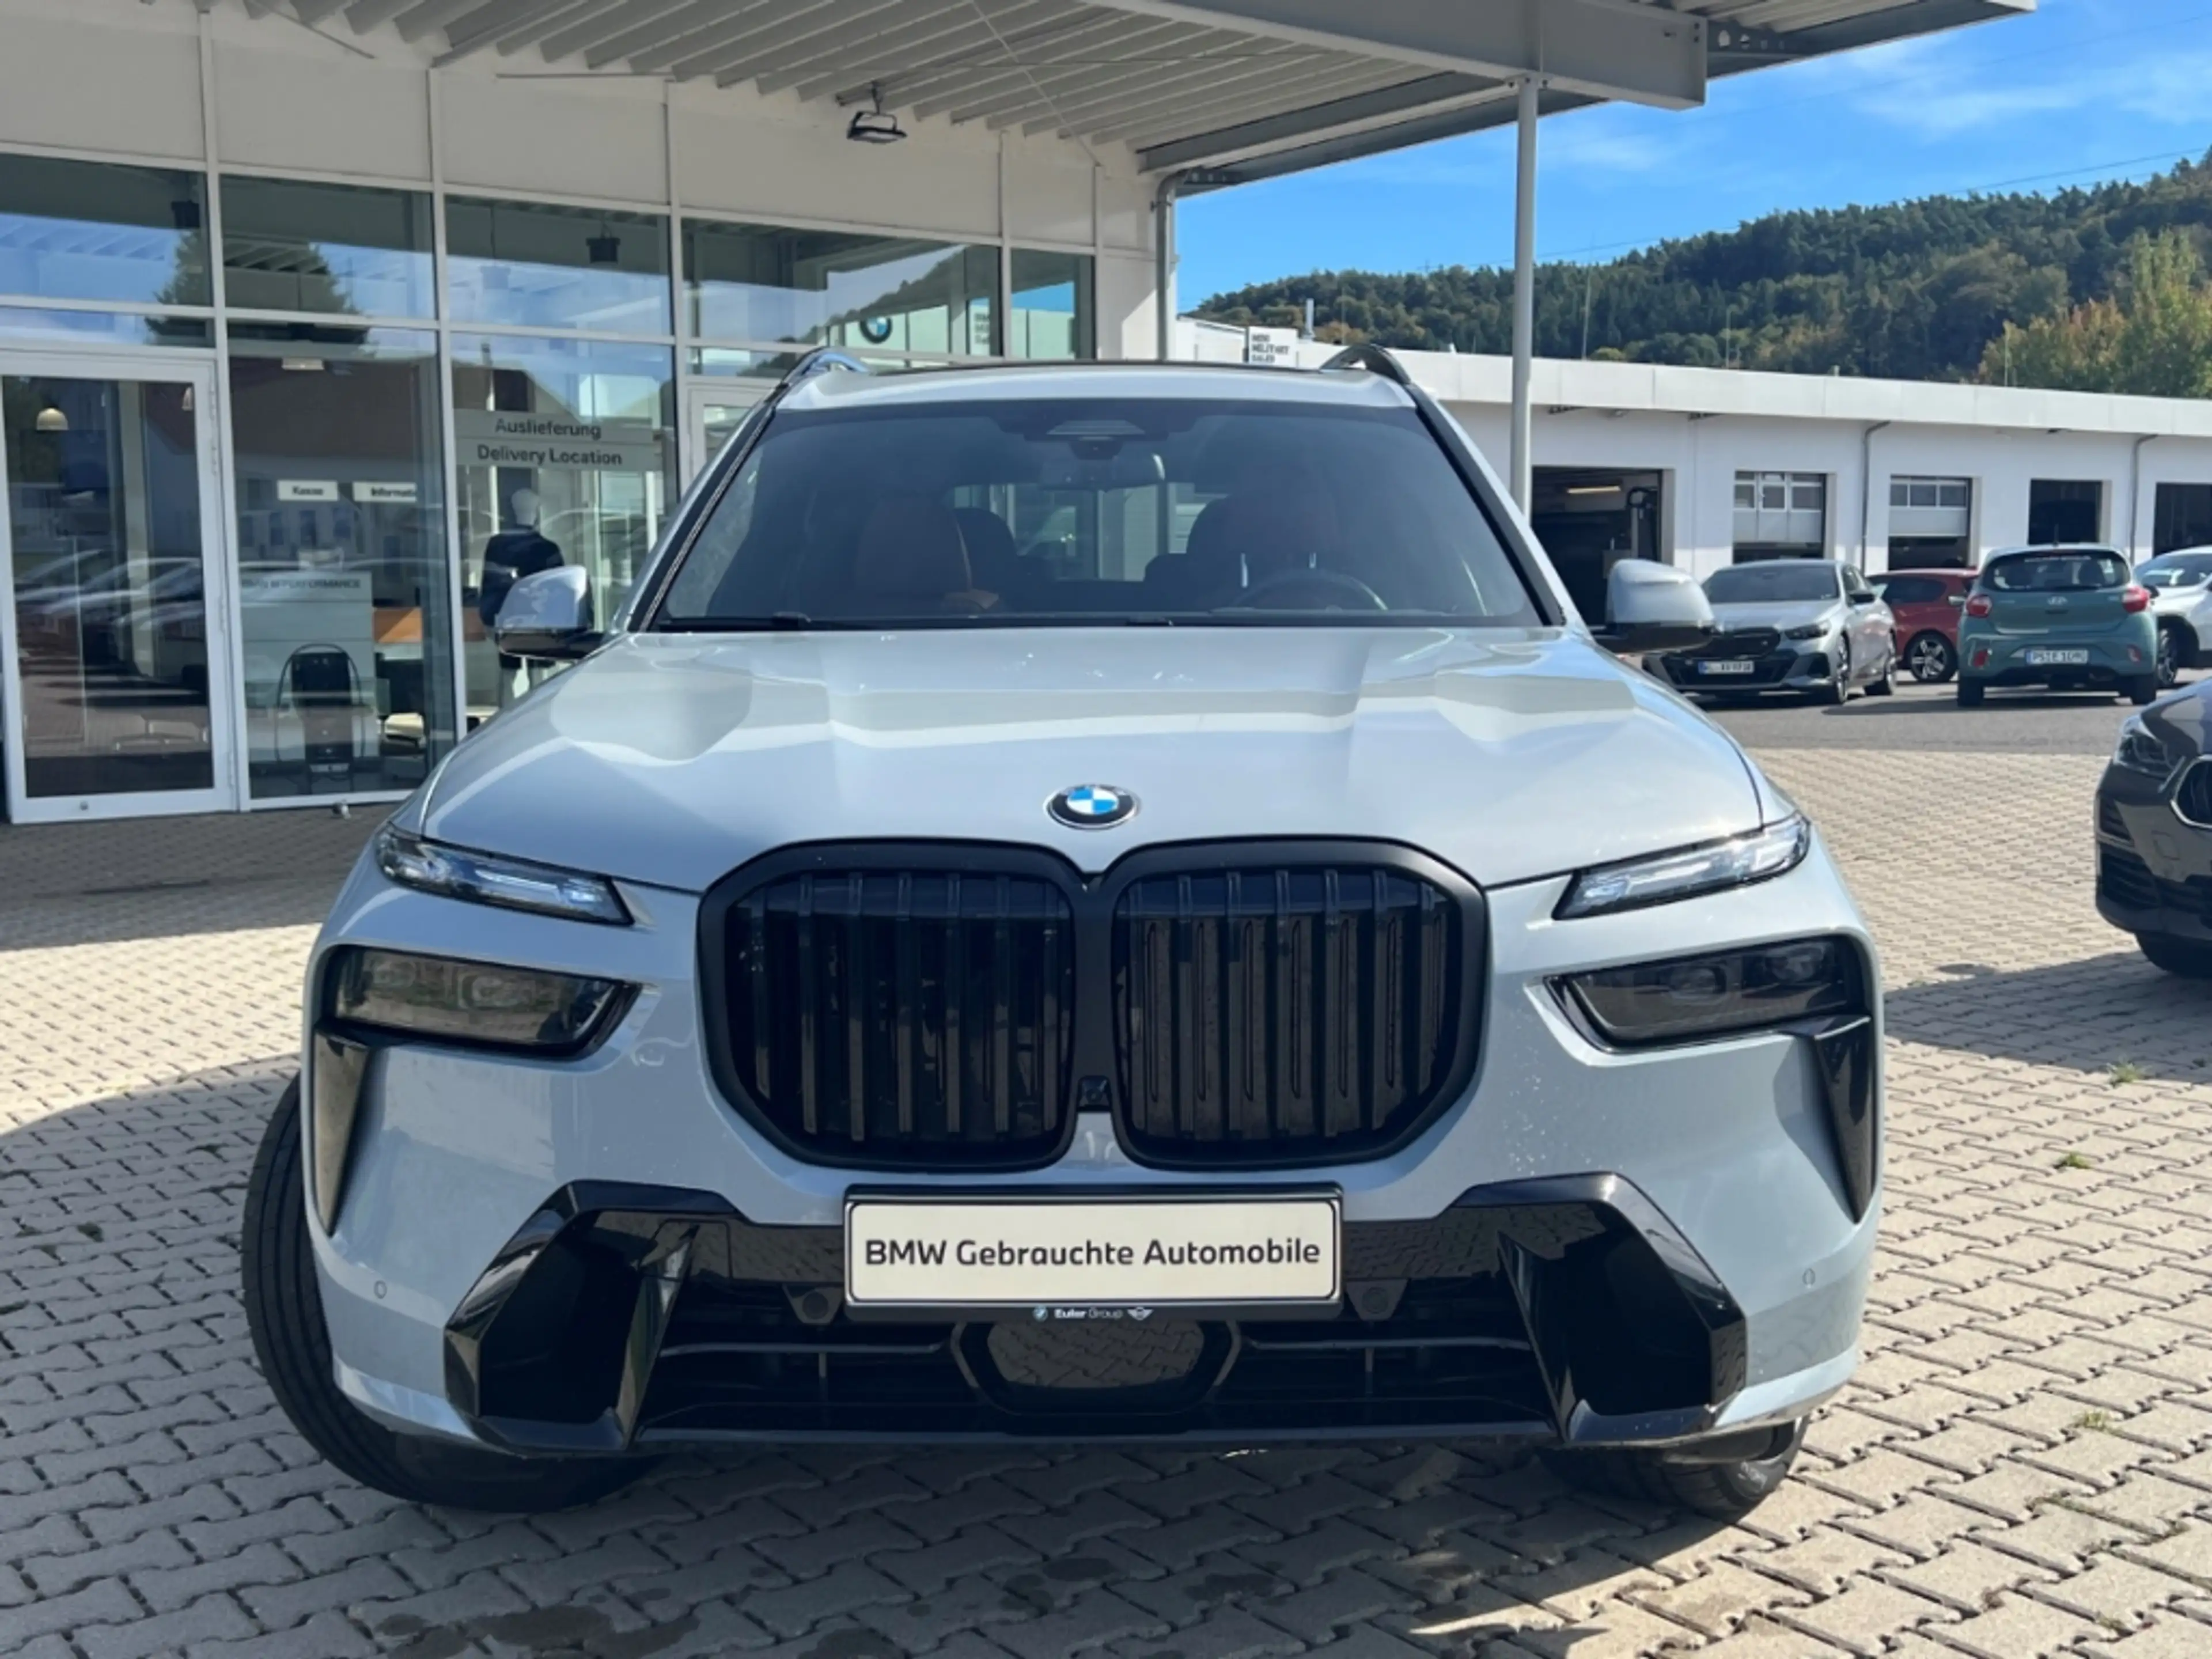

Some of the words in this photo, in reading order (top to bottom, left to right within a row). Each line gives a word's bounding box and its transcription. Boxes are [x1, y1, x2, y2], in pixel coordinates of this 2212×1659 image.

[495, 418, 601, 441] Auslieferung
[477, 444, 546, 465] Delivery
[549, 448, 622, 465] Location
[865, 1239, 947, 1266] BMW
[956, 1240, 1134, 1266] Gebrauchte
[1143, 1238, 1320, 1265] Automobile
[1054, 1308, 1087, 1319] Euler
[1088, 1308, 1123, 1319] Group
